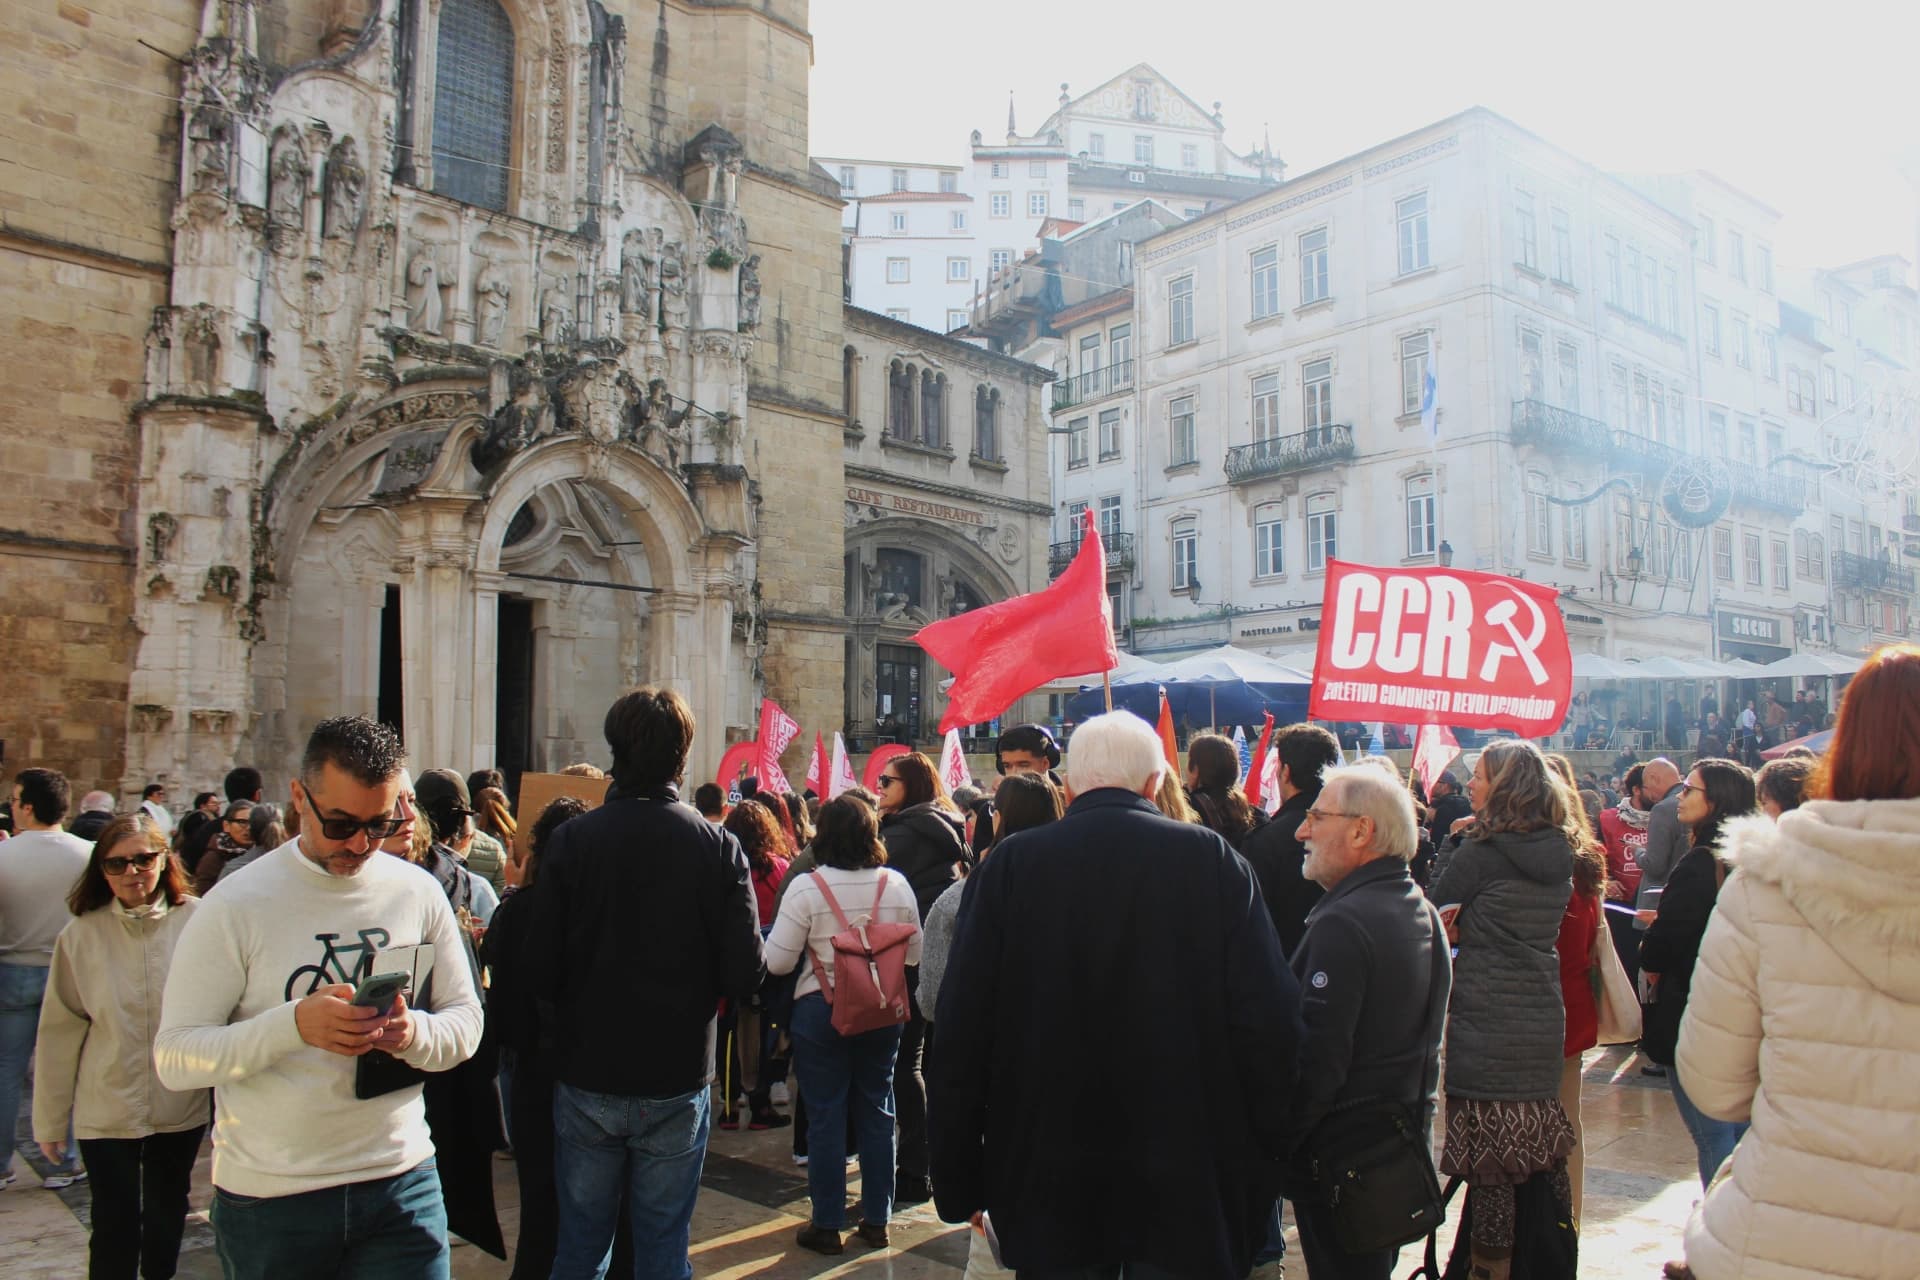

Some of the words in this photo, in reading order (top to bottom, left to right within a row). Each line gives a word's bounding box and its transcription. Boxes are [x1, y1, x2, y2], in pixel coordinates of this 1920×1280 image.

[893, 496, 984, 524] RESTAURANTE
[1241, 625, 1293, 637] PASTELARIA
[1331, 573, 1473, 680] CCR
[1379, 684, 1451, 712] COMUNISTA
[1452, 691, 1556, 720] REVOLUCIONÁRIO
[1623, 832, 1648, 844] GRE
